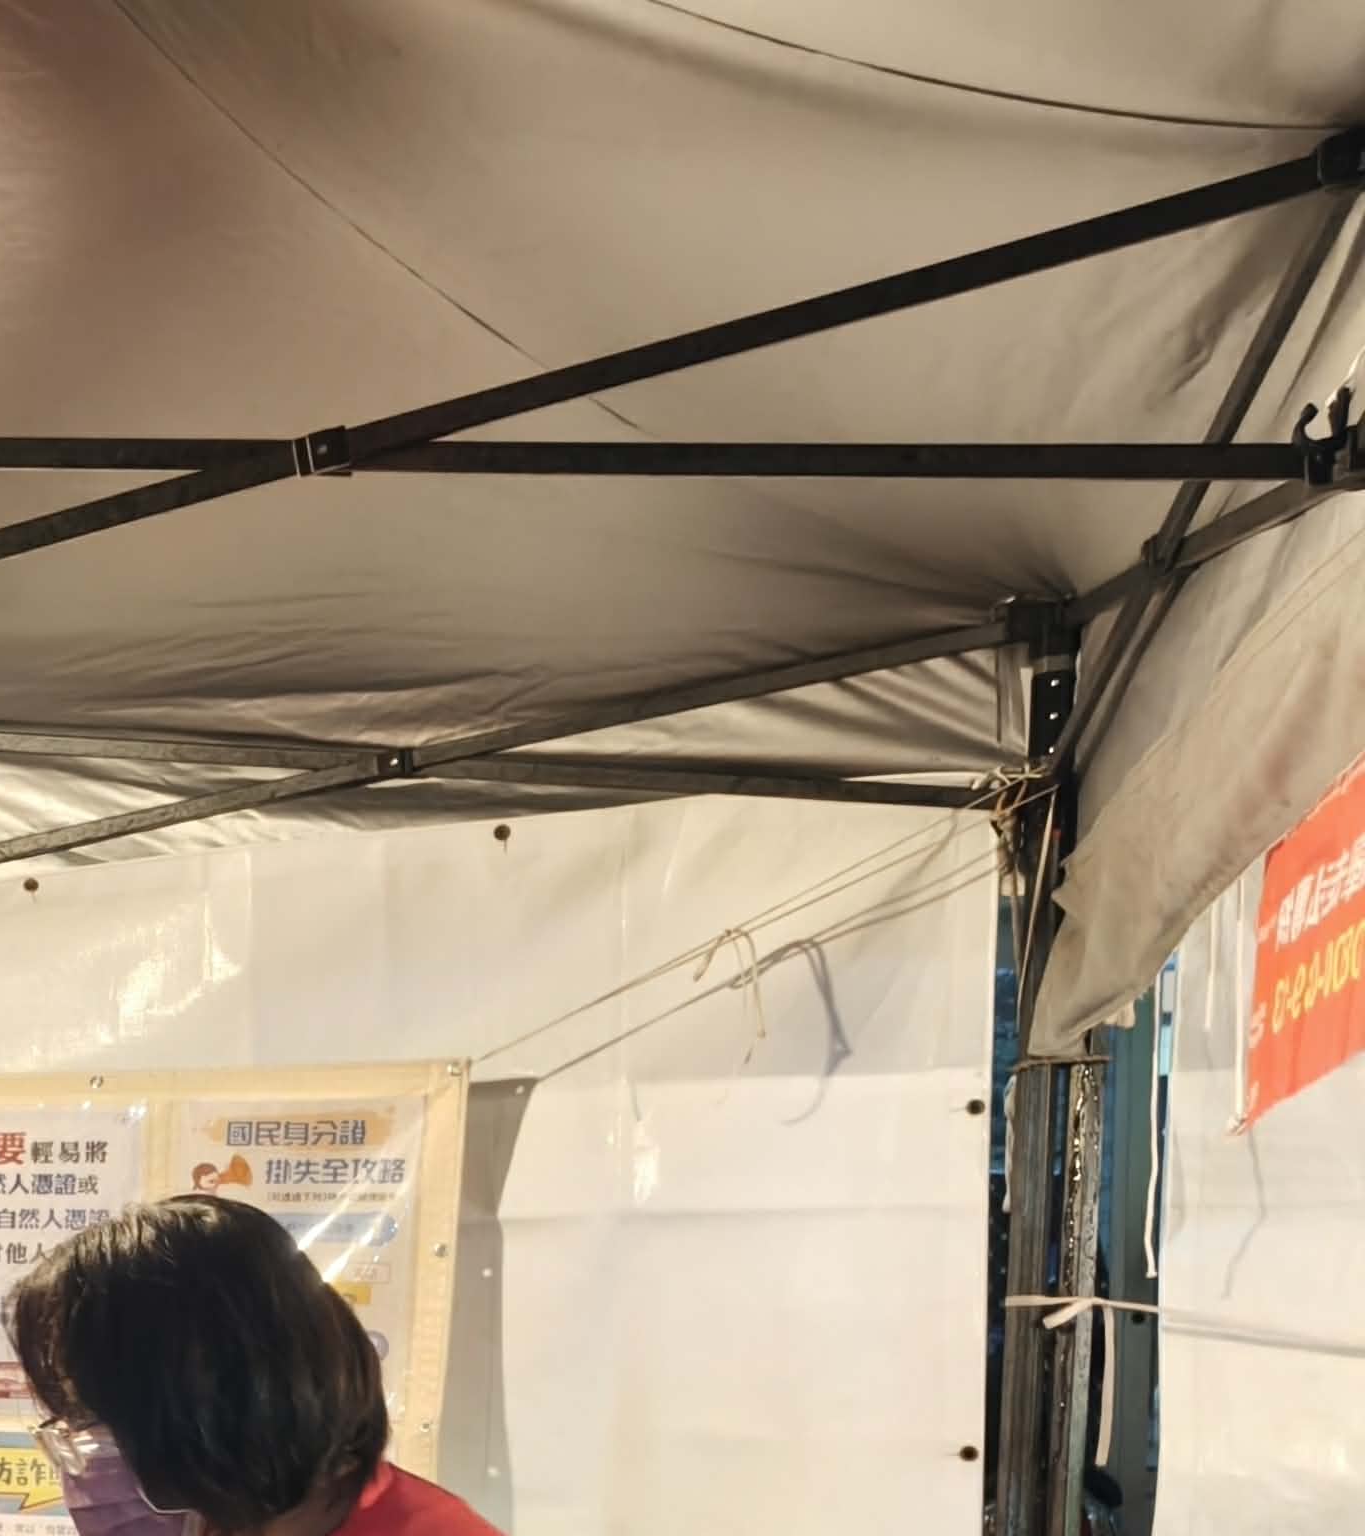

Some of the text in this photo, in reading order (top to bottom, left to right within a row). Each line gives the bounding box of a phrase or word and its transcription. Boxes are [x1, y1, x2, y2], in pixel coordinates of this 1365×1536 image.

[226, 1119, 367, 1147] 國民身分證
[264, 1157, 407, 1185] 掛失全攻略
